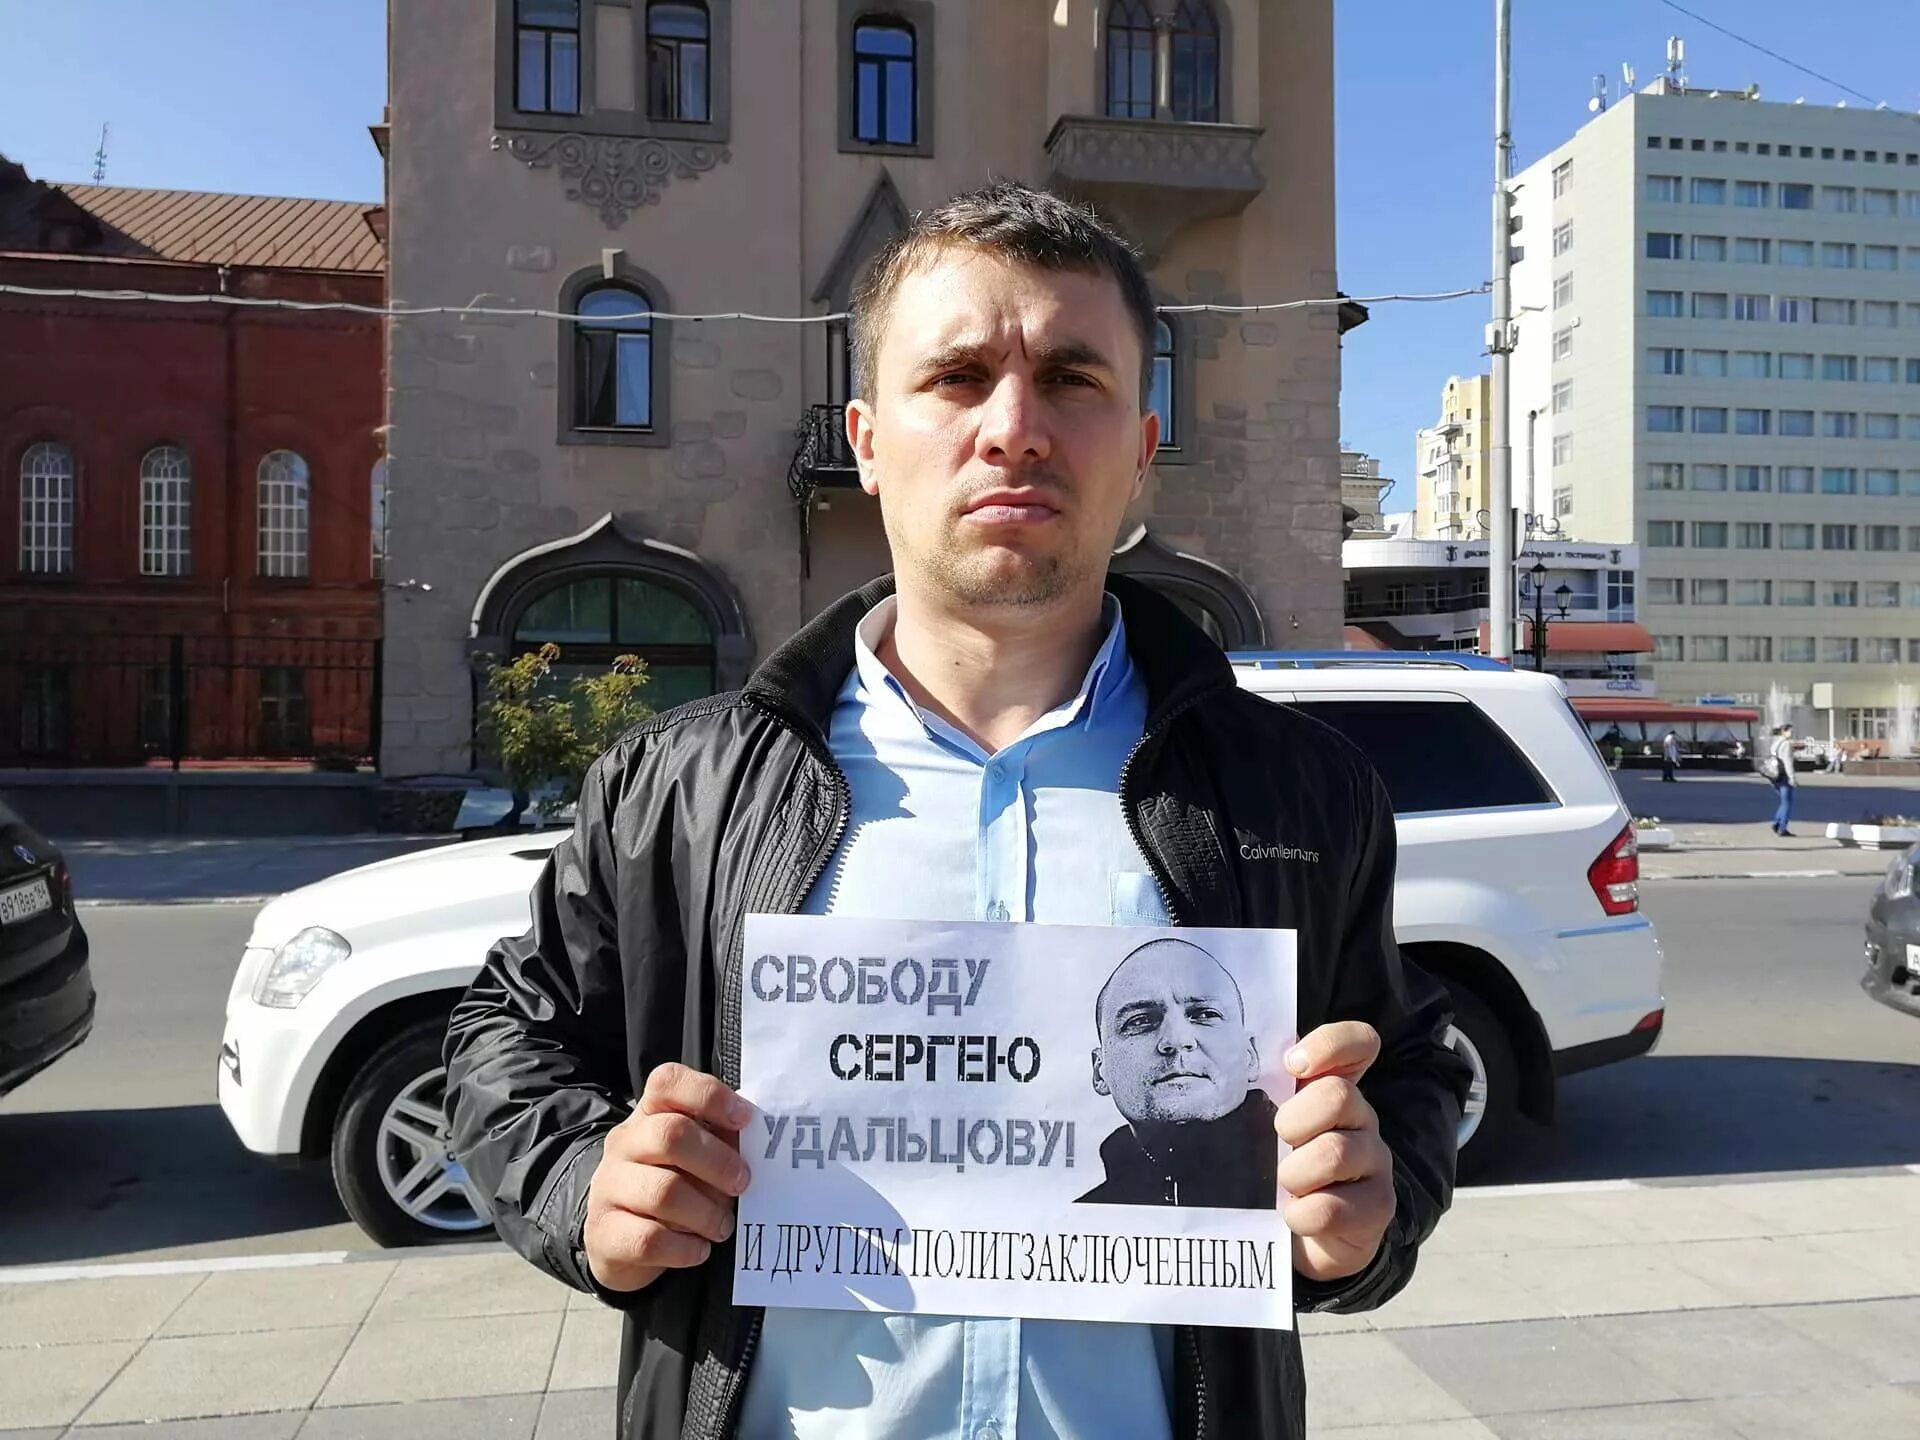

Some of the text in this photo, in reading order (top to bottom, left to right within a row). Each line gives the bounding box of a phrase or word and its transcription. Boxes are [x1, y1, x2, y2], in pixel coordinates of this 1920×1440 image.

[750, 954, 991, 1017] СВОБОДУ
[829, 1033, 1041, 1083] СЕРГЕЮ
[763, 1116, 1076, 1173] УДАЛЬЦОВУ!
[741, 1223, 1276, 1290] И ДРУГИМ ПОЛИТЗАКЛЮЧЕННЫМ
